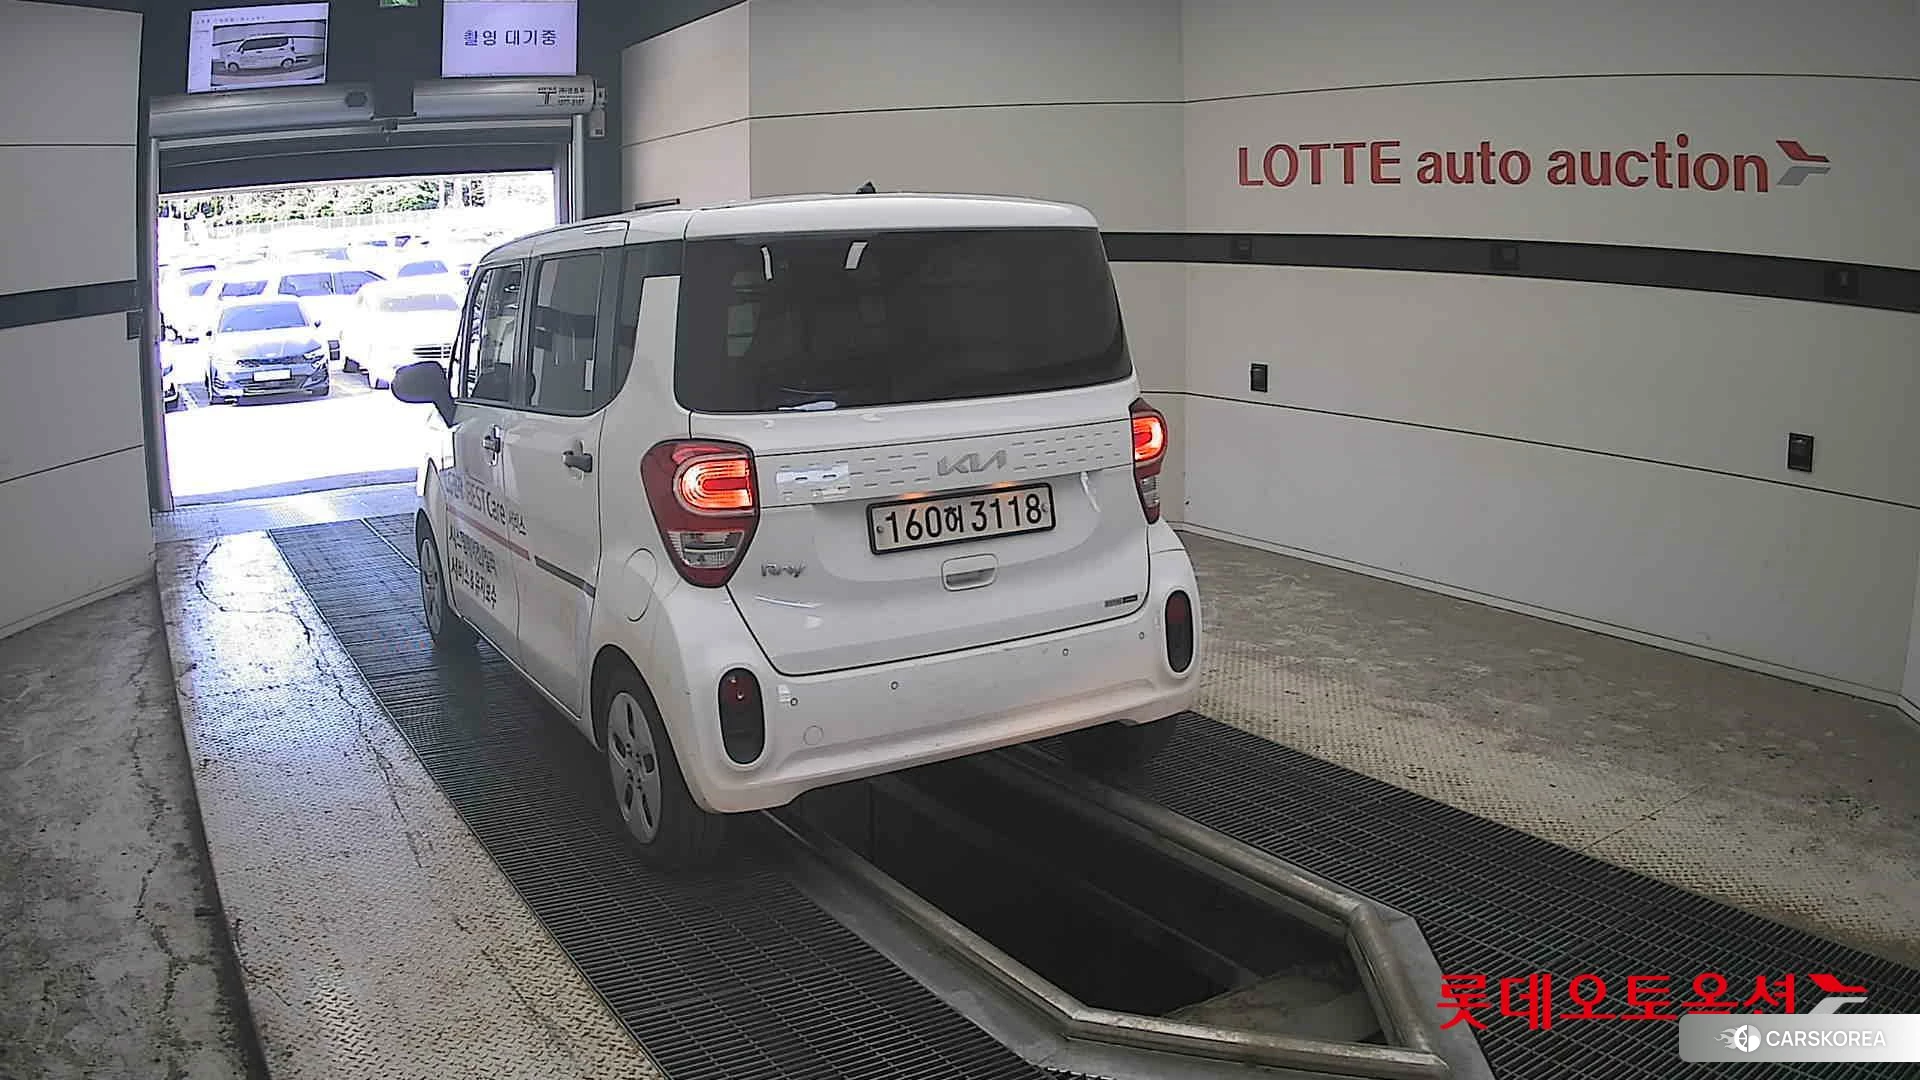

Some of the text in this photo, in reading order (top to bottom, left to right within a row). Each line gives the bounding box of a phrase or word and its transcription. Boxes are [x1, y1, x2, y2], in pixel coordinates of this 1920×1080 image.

[505, 29, 557, 46] 대기중
[1239, 134, 1769, 192] LOTTE auto auction
[885, 493, 1043, 543] 160허 3118
